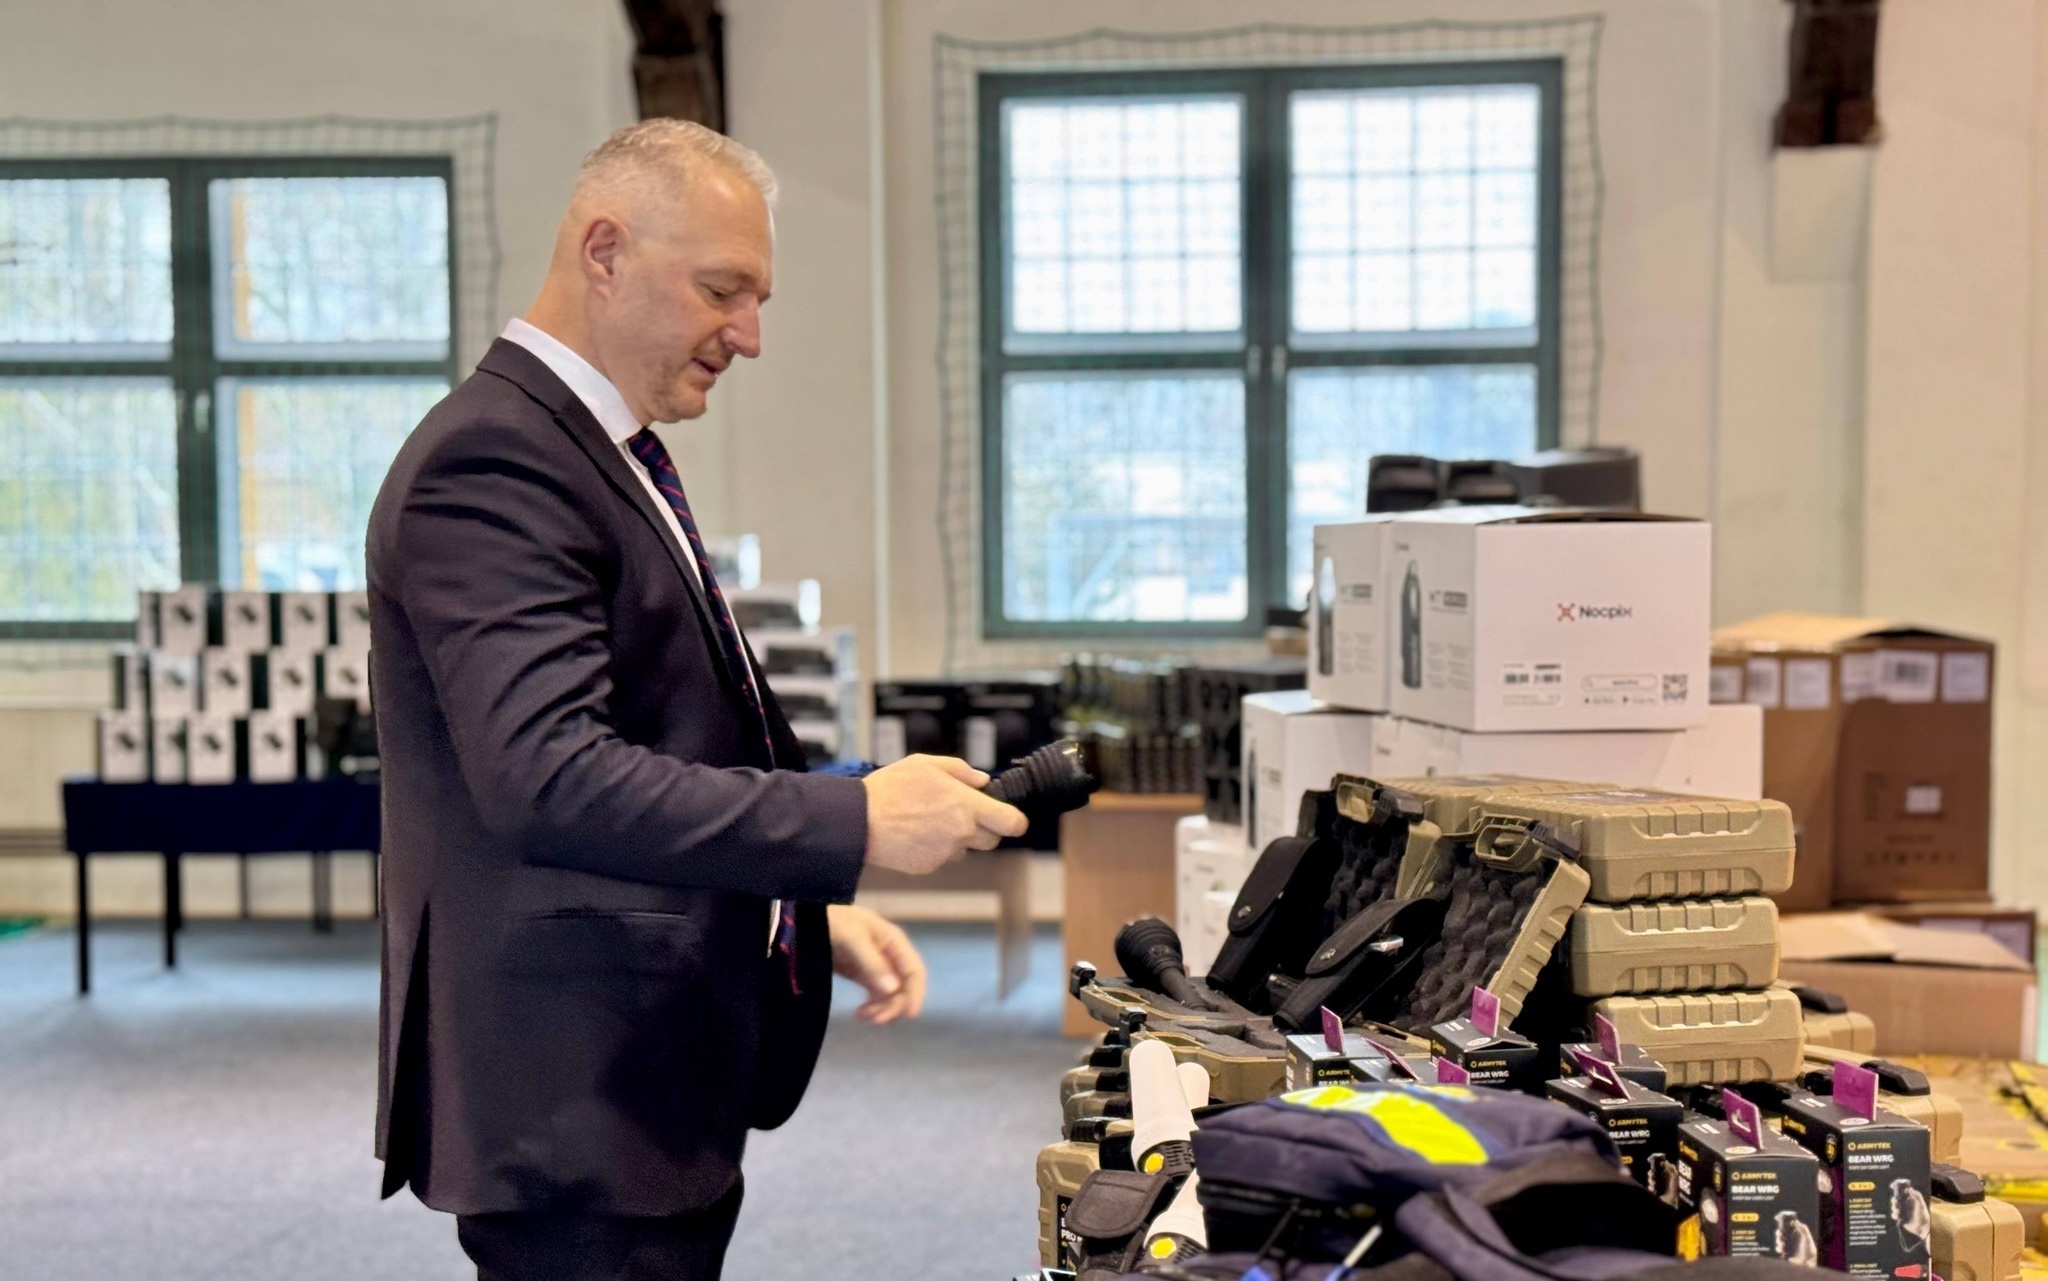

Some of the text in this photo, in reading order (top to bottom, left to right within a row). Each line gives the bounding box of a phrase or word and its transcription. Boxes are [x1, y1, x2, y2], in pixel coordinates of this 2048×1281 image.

[1579, 604, 1632, 620] Nocpix
[1470, 1070, 1509, 1079] BEAR WRG
[1616, 1118, 1648, 1126] ARMYTEK
[1609, 1130, 1650, 1139] BEAR WRG
[1857, 1142, 1892, 1150] ARMYTEK
[1848, 1154, 1894, 1164] BEAR WRG
[1741, 1172, 1777, 1180] ARMYTEK
[1731, 1185, 1780, 1194] BEAR WRG
[1061, 1229, 1077, 1242] PRO
